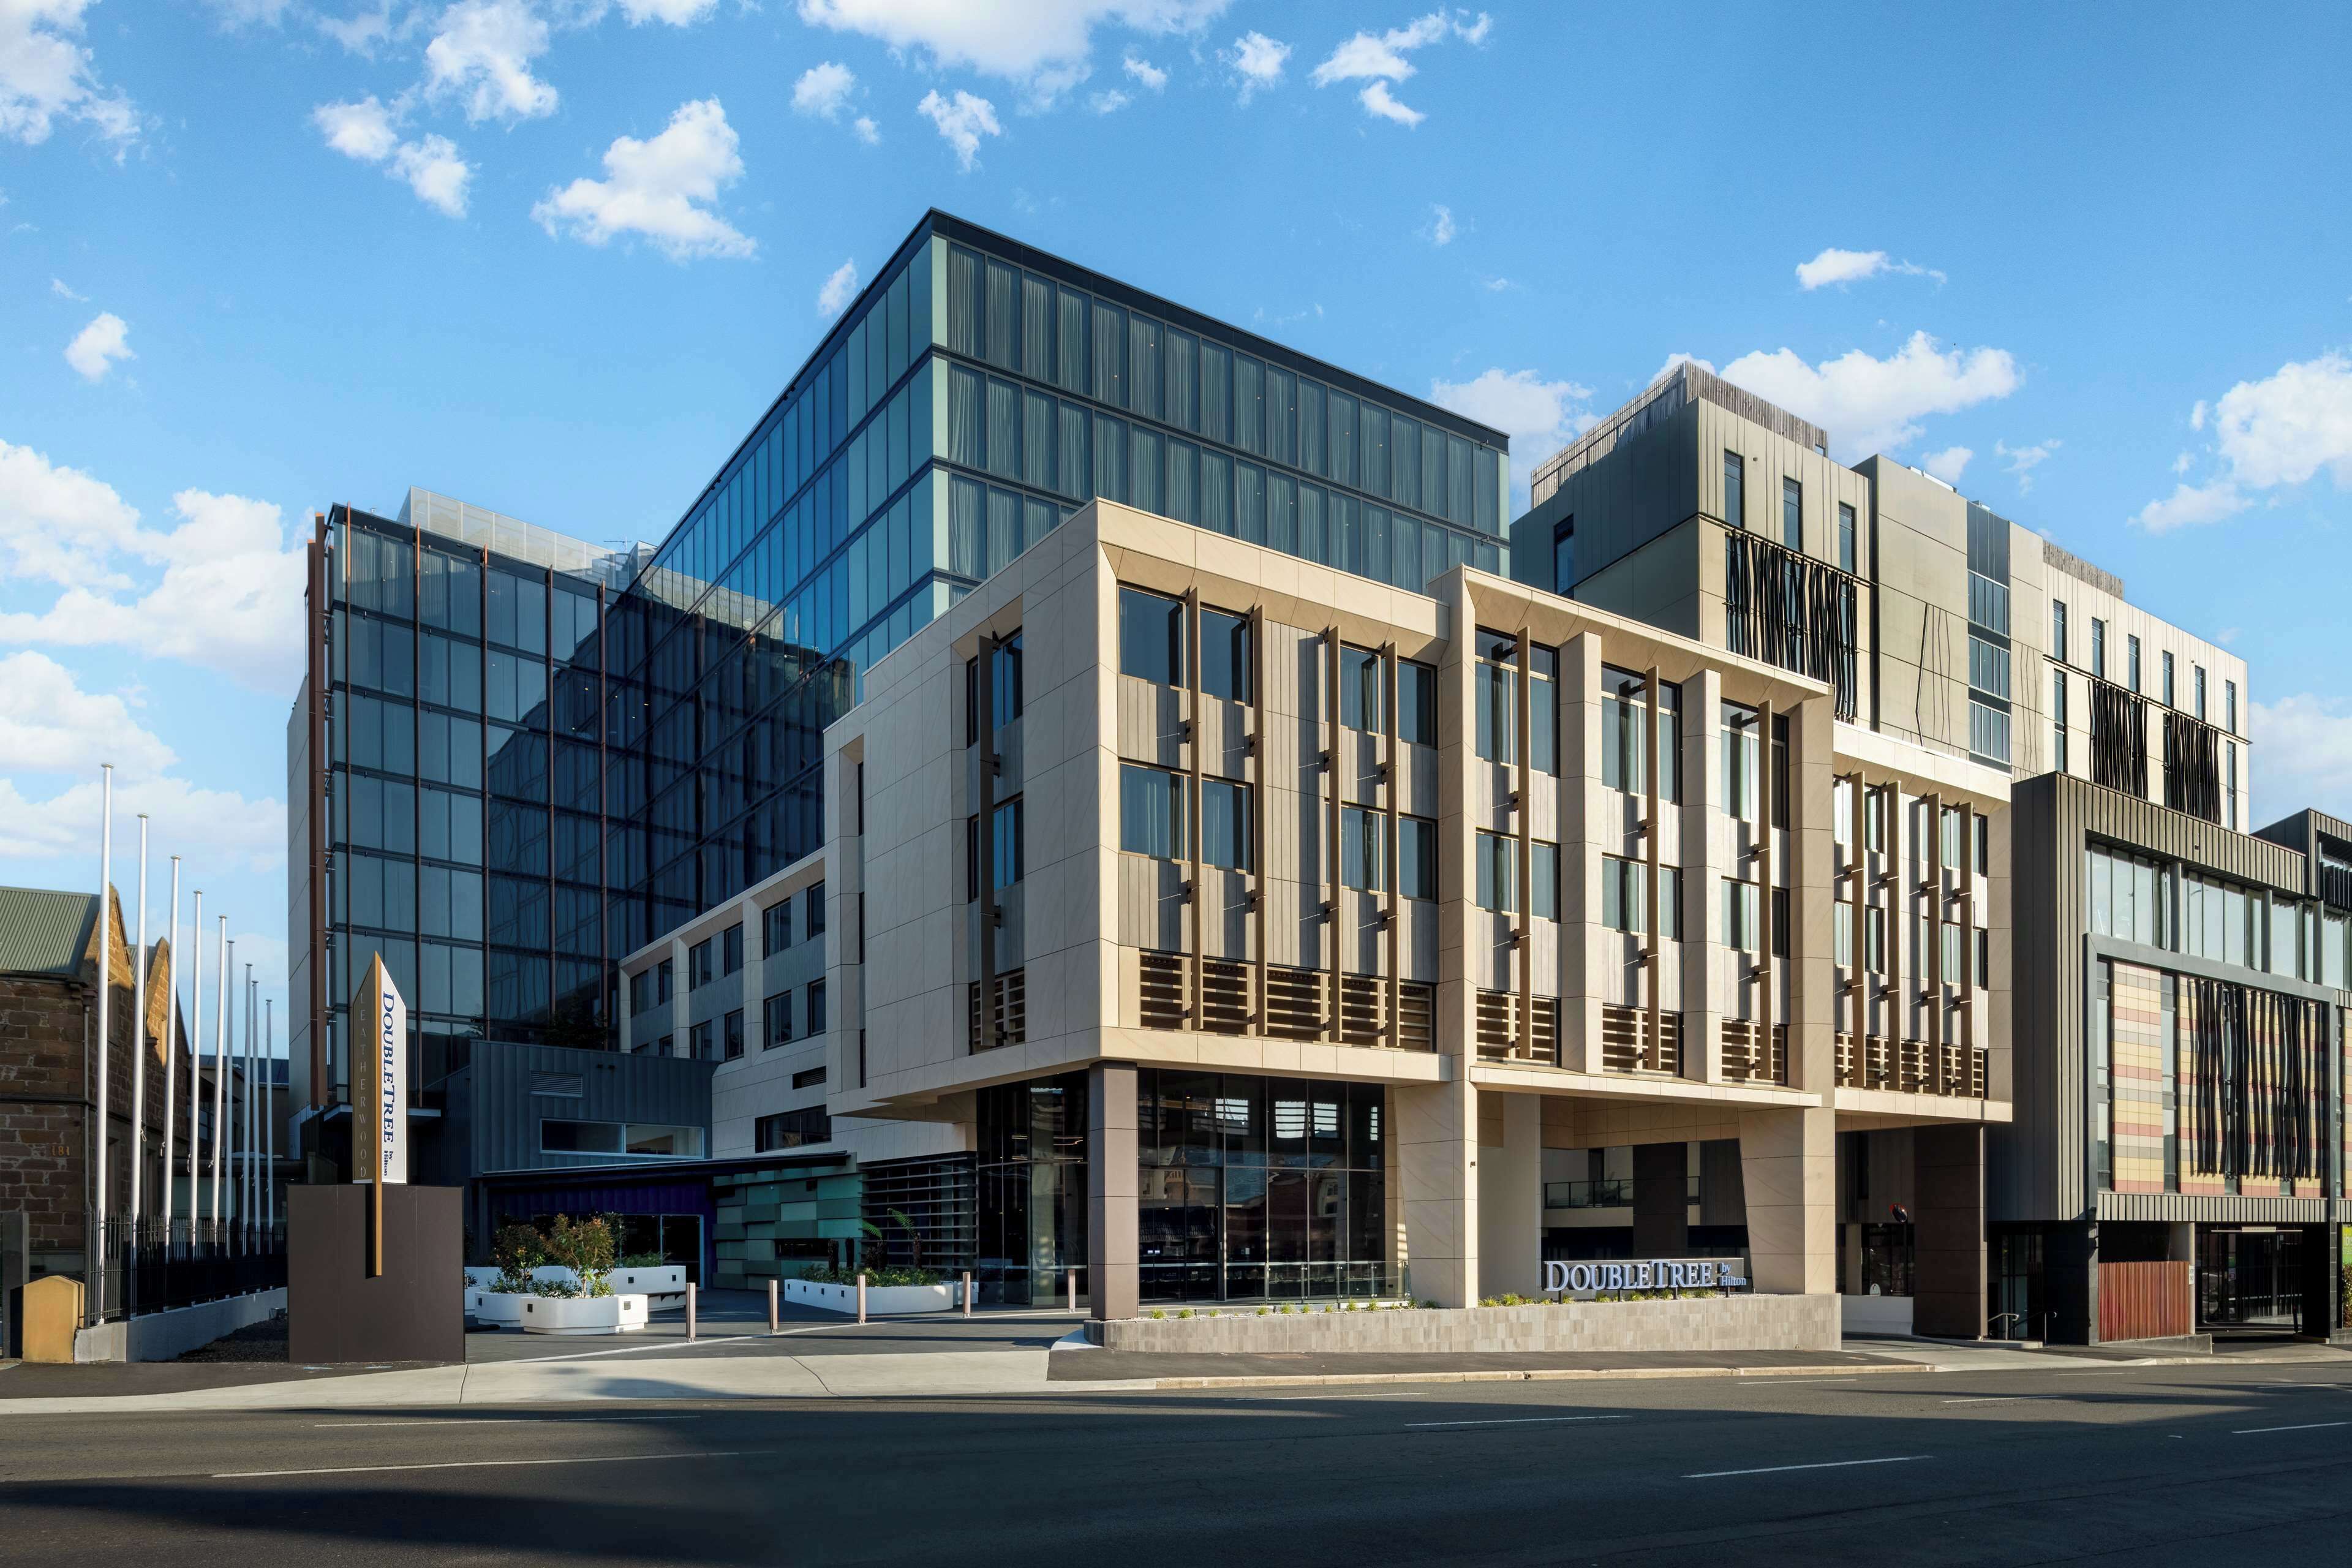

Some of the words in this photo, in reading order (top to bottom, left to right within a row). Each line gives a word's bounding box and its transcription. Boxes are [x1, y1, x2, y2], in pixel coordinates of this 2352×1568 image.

[389, 1151, 393, 1160] by
[1721, 1262, 1731, 1275] by
[1720, 1276, 1747, 1286] Hilton
